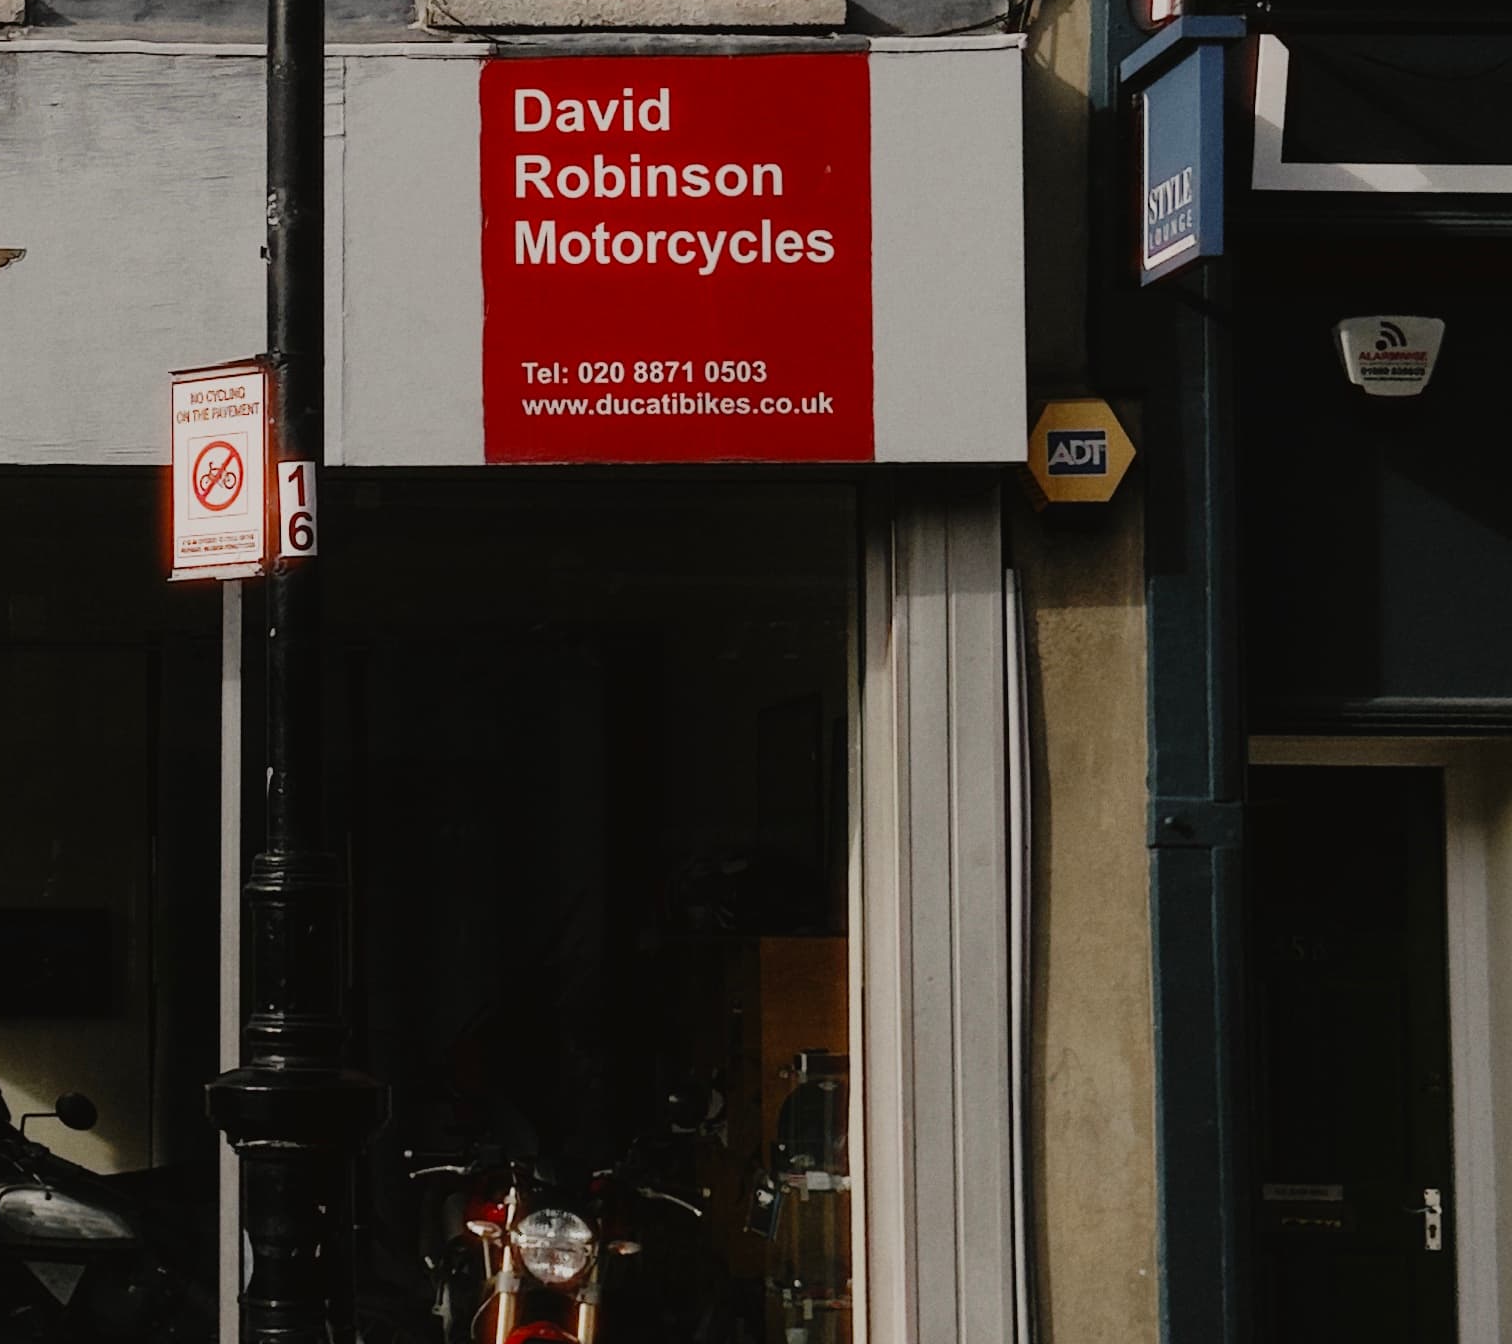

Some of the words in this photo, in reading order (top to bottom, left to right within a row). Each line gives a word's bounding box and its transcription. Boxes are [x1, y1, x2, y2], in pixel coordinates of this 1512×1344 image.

[514, 87, 671, 133] David
[514, 153, 784, 199] Robinson
[1148, 166, 1193, 225] STYLE
[514, 219, 836, 276] Motorcycles
[521, 362, 569, 384] Tel:
[577, 362, 625, 384] 020
[633, 362, 694, 384] 8871
[704, 360, 768, 383] 0503
[190, 392, 204, 405] NO
[206, 386, 246, 403] CYCLING
[521, 392, 834, 416] www.ducatibikes.co.uk
[193, 407, 210, 423] THE
[212, 402, 260, 420] PAVEMENT
[1048, 439, 1107, 466] ADT
